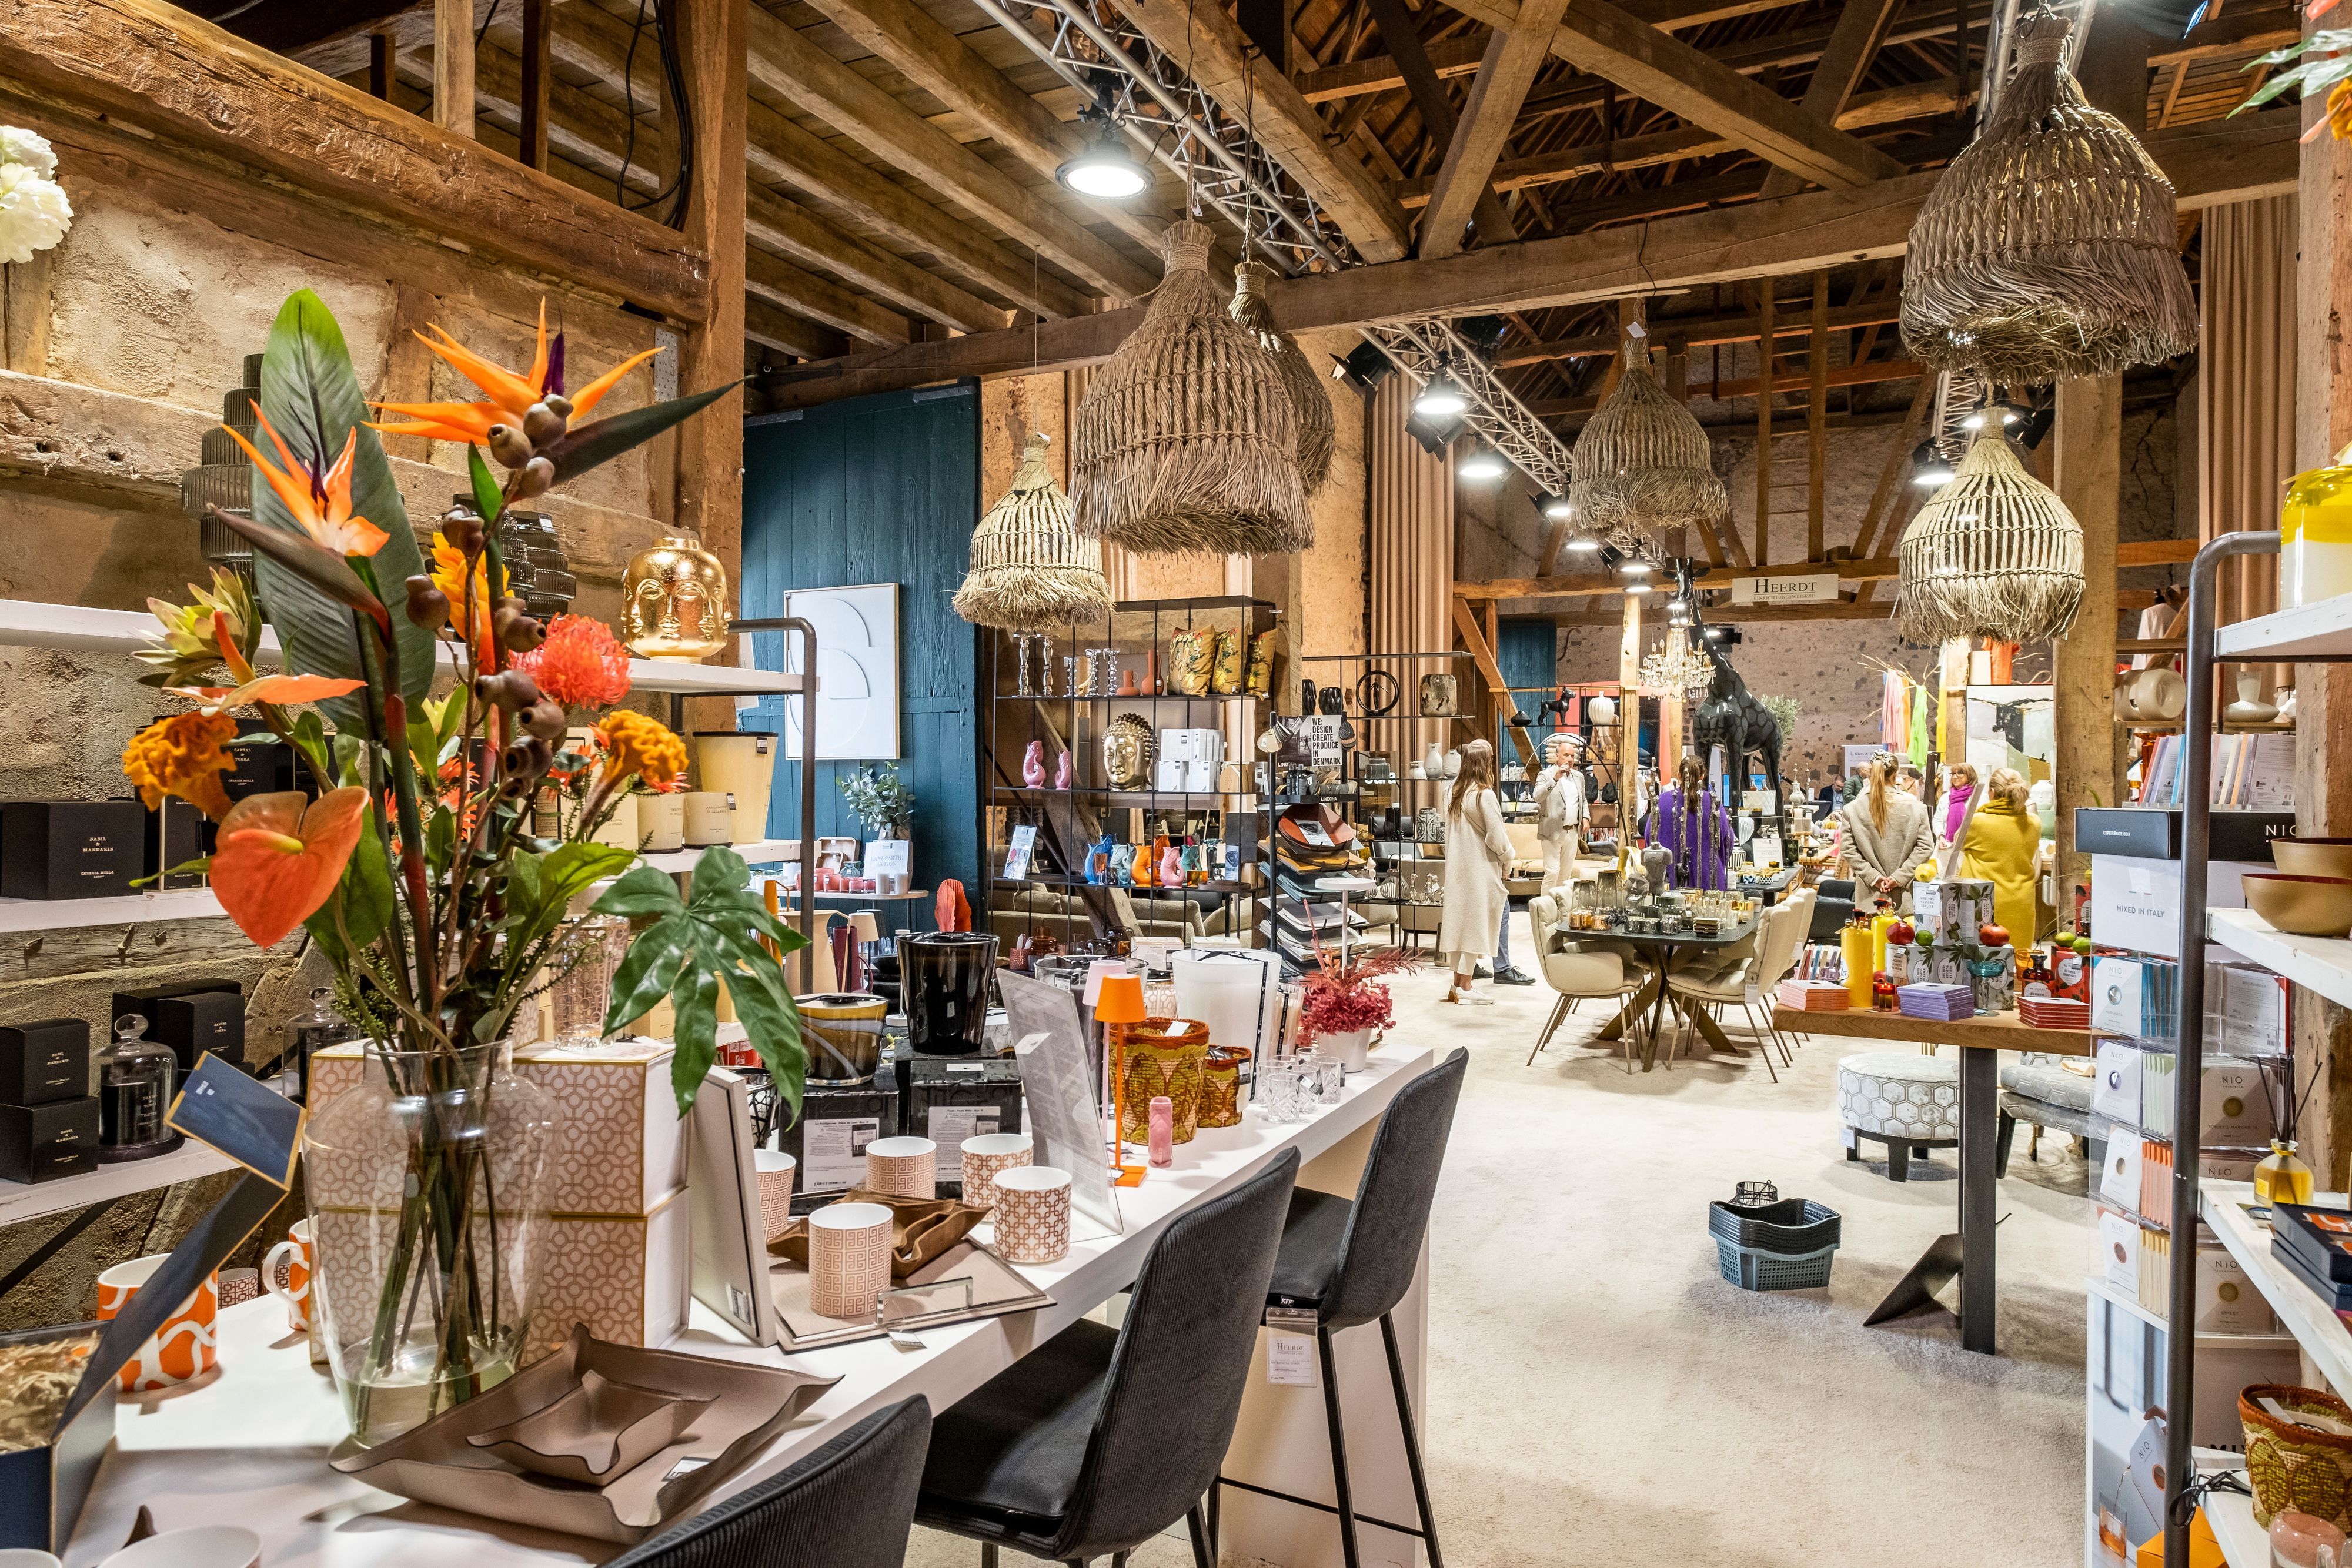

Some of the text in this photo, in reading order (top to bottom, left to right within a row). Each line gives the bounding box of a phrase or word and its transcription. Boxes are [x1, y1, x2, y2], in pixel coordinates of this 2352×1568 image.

[1755, 579, 1817, 593] HEERDT
[1312, 726, 1332, 734] DESIGN
[1313, 757, 1341, 765] DENMARK
[2117, 905, 2136, 914] MIXED
[2147, 909, 2165, 918] ITALY
[2109, 966, 2123, 974] NIO
[2111, 1051, 2123, 1060] NIO
[2222, 1076, 2243, 1084] NIO
[2209, 1168, 2232, 1176] NIO
[2138, 1441, 2150, 1459] NIO
